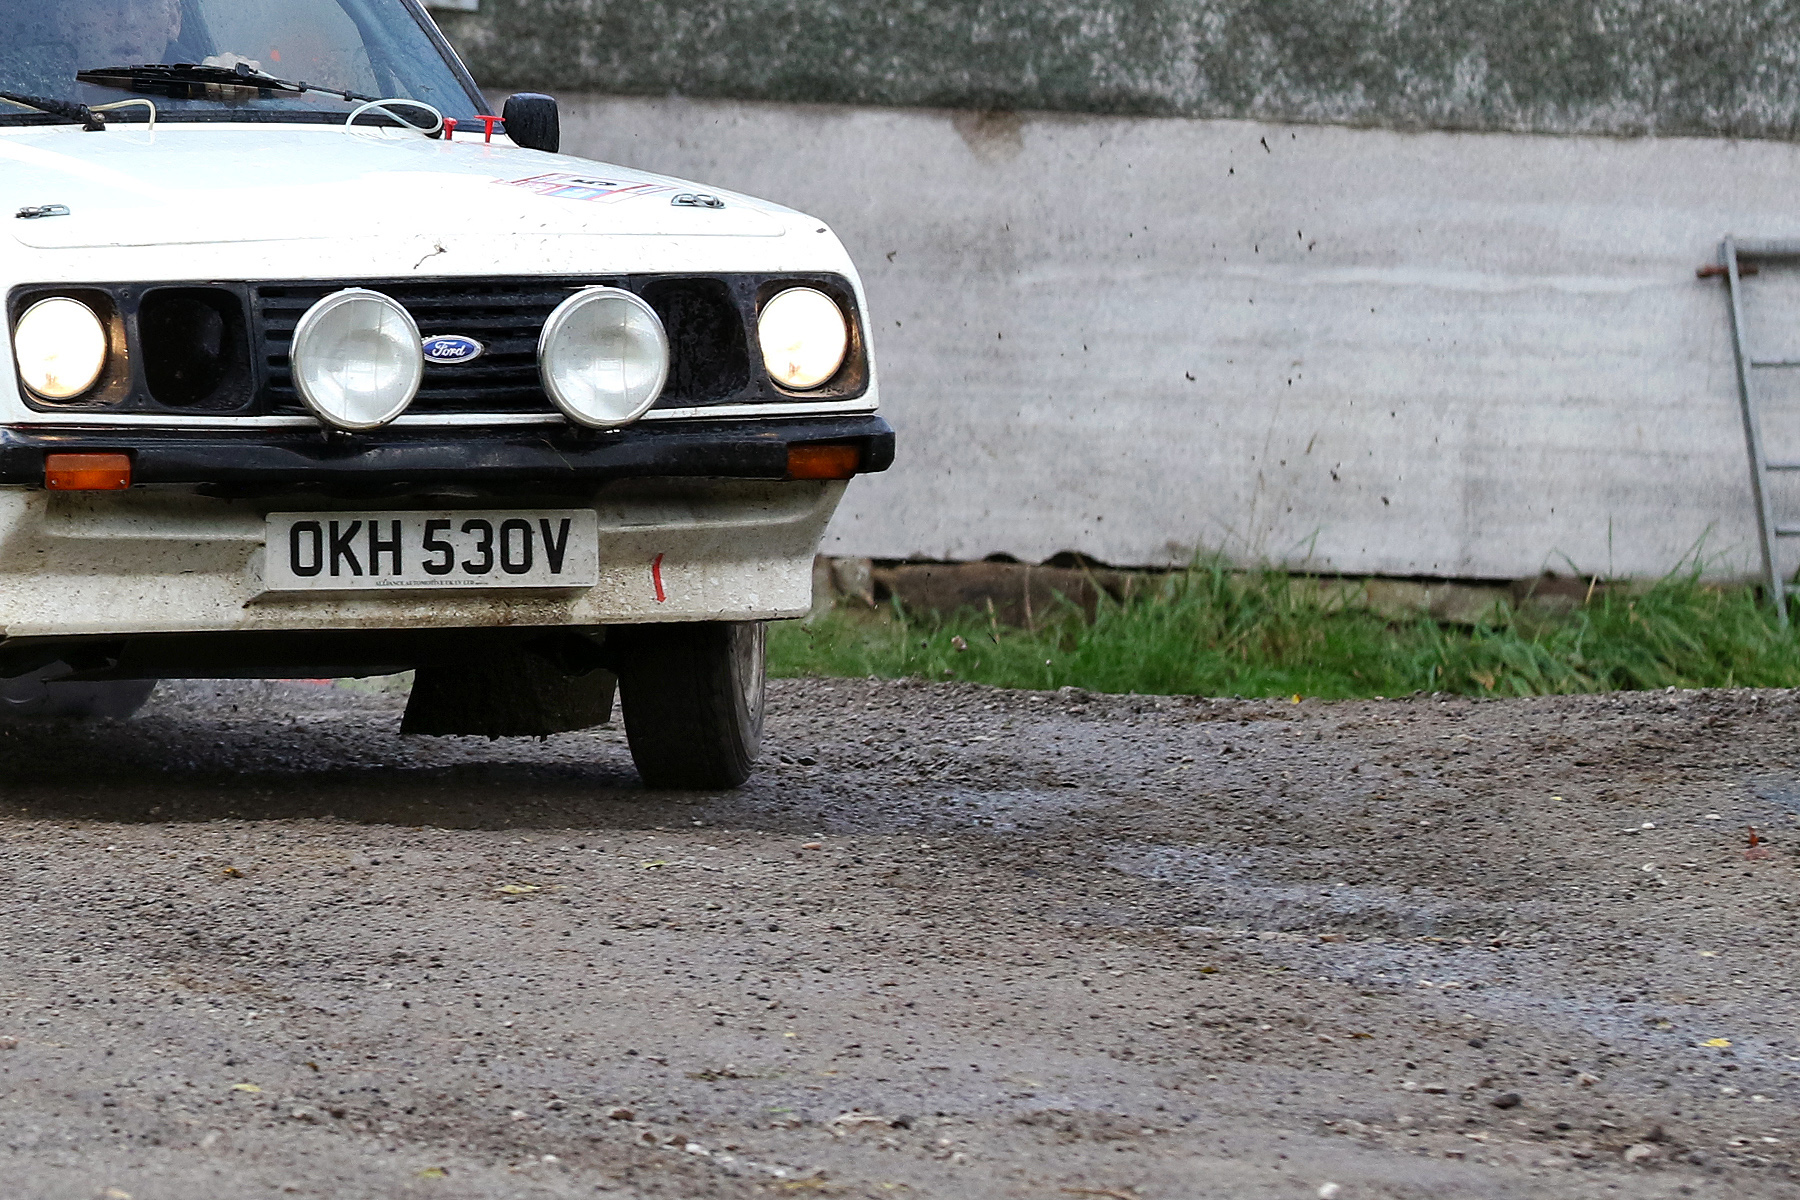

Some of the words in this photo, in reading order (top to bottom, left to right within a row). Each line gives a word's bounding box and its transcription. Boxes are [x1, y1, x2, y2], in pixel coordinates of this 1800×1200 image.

[431, 341, 467, 356] Ford
[289, 520, 402, 577] OKH
[422, 518, 571, 576] 530V
